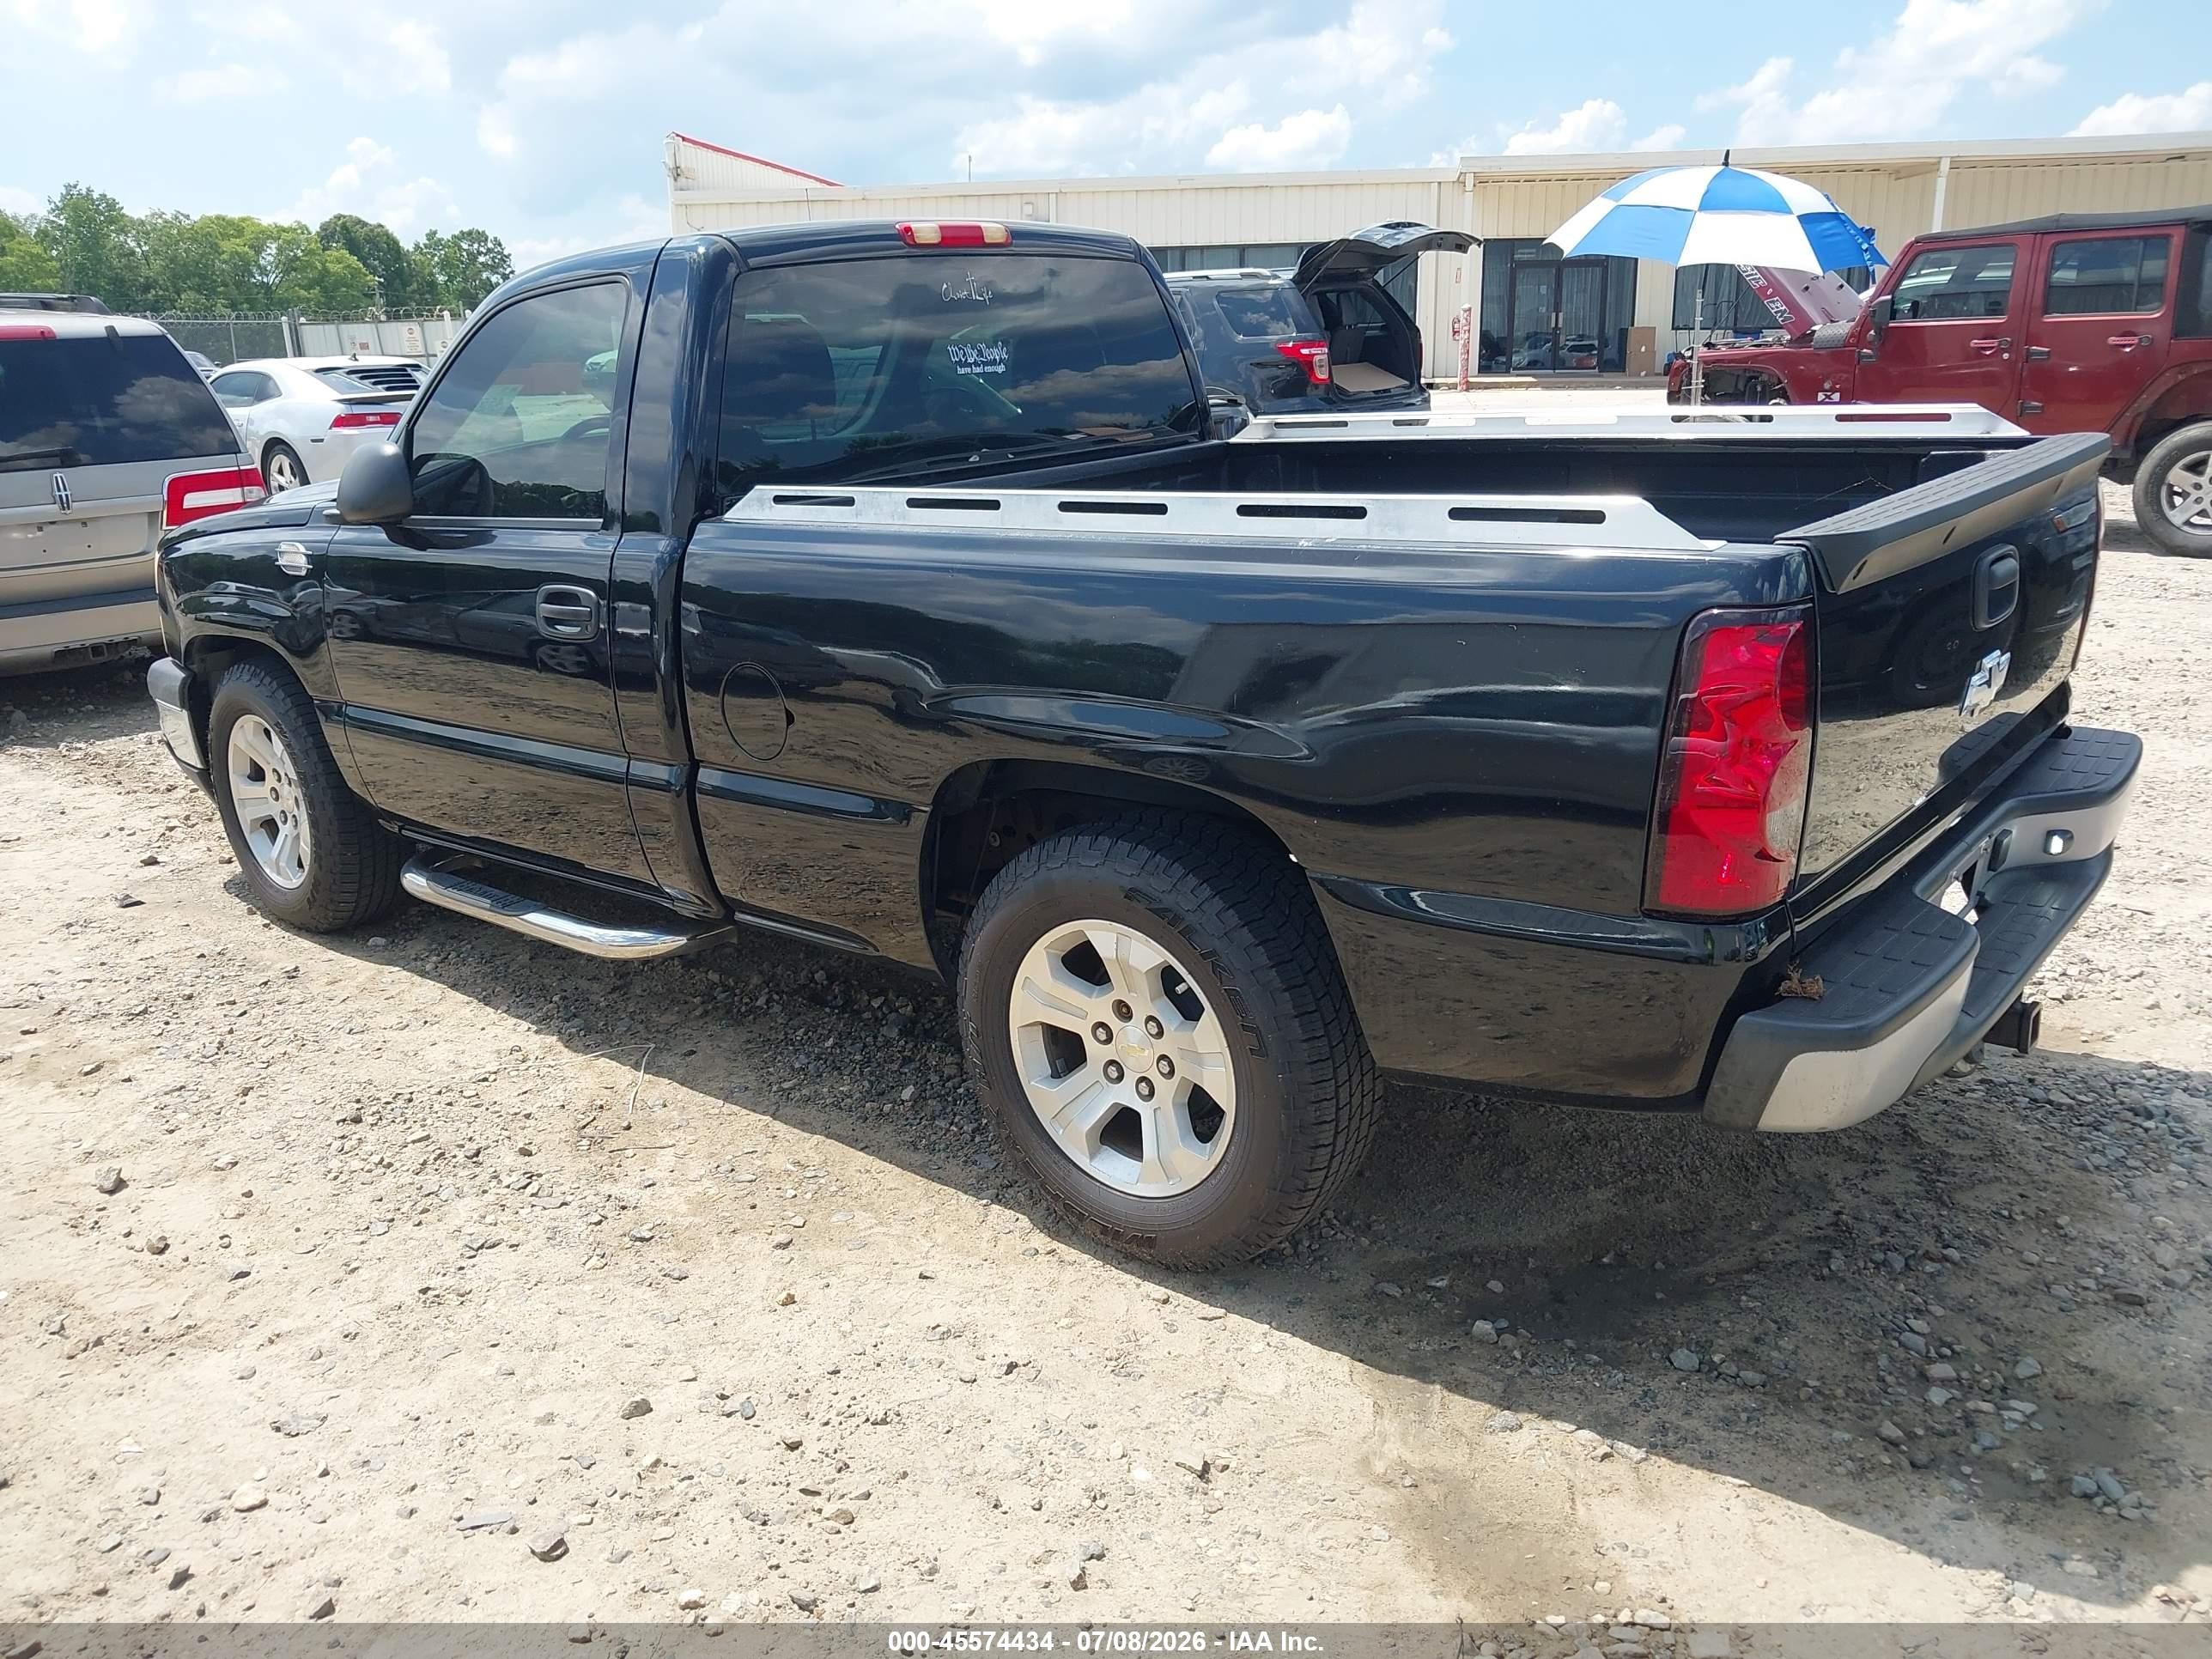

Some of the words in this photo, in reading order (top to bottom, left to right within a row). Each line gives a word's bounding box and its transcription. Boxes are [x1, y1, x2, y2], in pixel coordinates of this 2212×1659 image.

[974, 282, 994, 305] Life
[947, 344, 966, 363] We
[977, 342, 1009, 364] People
[957, 365, 971, 374] have
[972, 363, 983, 373] had
[984, 363, 1006, 374] enough
[1123, 886, 1267, 1060] FALKEN
